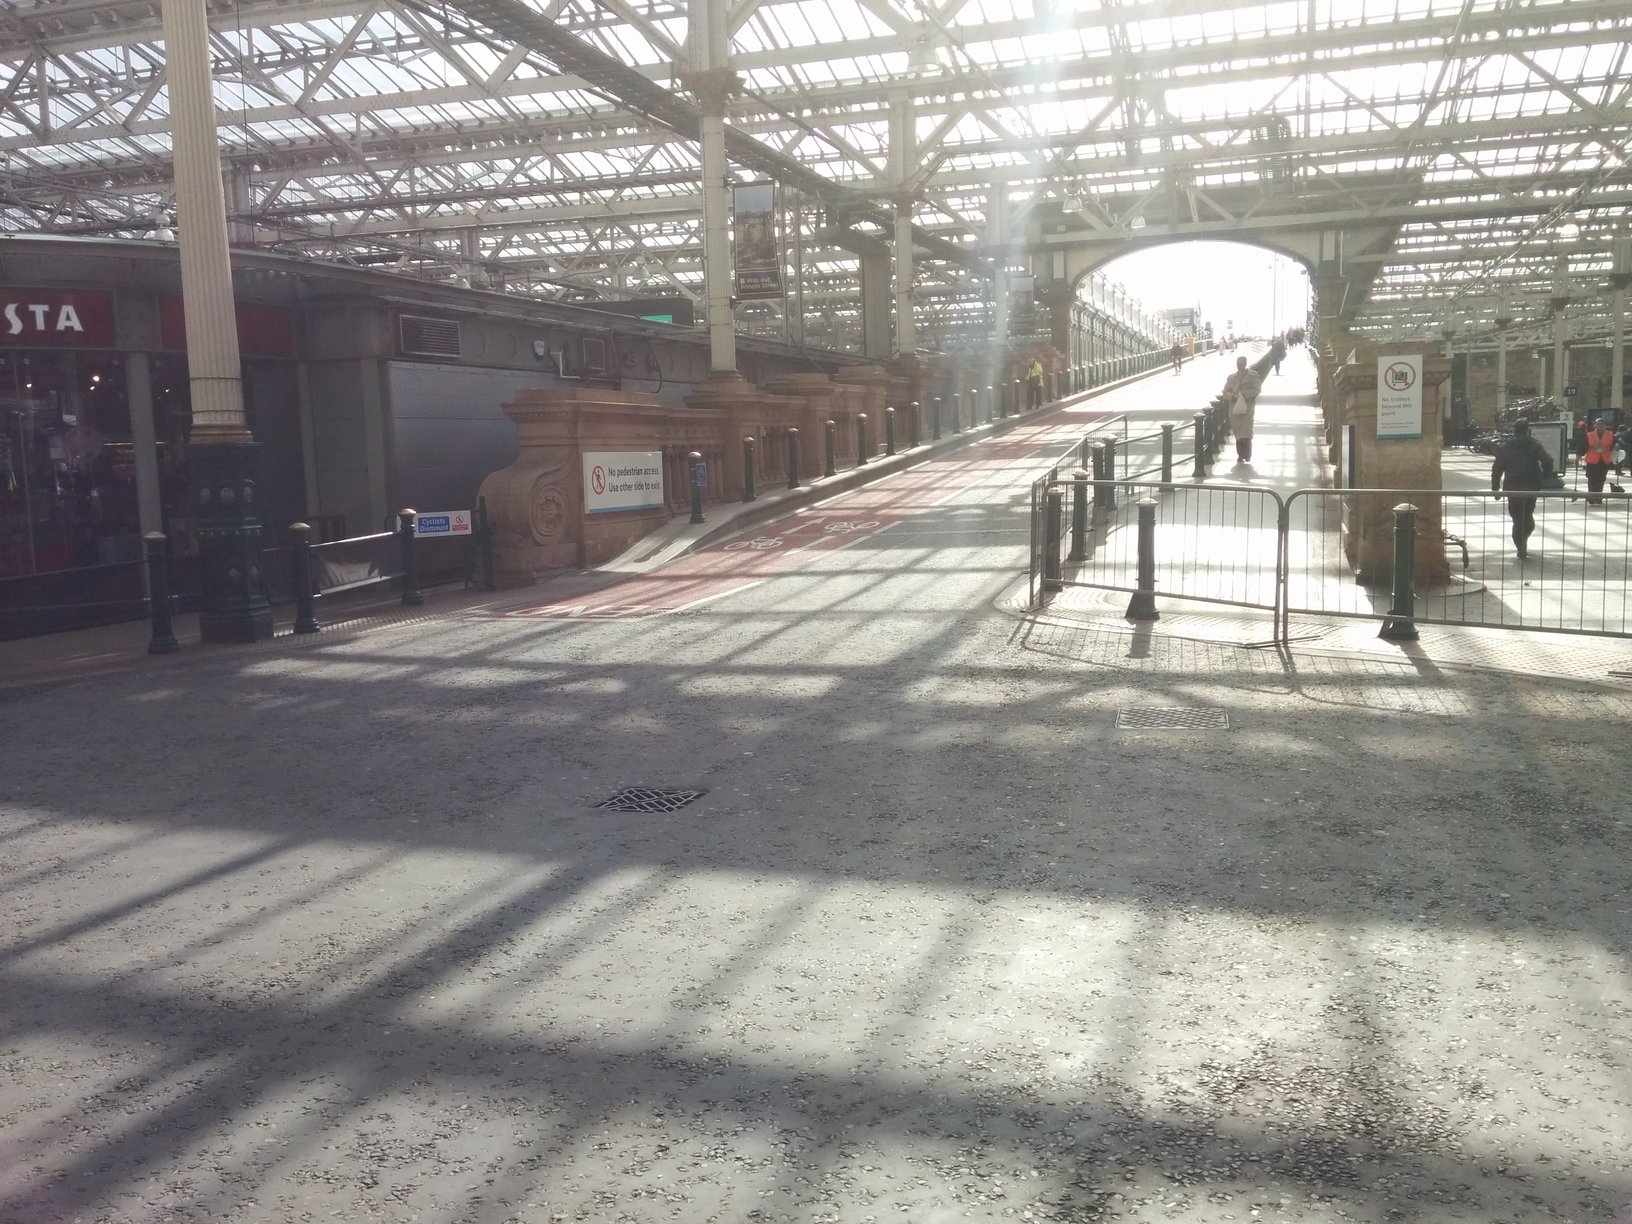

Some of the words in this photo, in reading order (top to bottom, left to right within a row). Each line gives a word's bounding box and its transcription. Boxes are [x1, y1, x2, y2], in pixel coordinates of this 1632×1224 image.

[608, 467, 616, 476] No
[617, 467, 643, 478] pedestrian
[608, 482, 618, 492] Use
[620, 482, 634, 492] other
[634, 481, 644, 491] side
[644, 482, 650, 490] to
